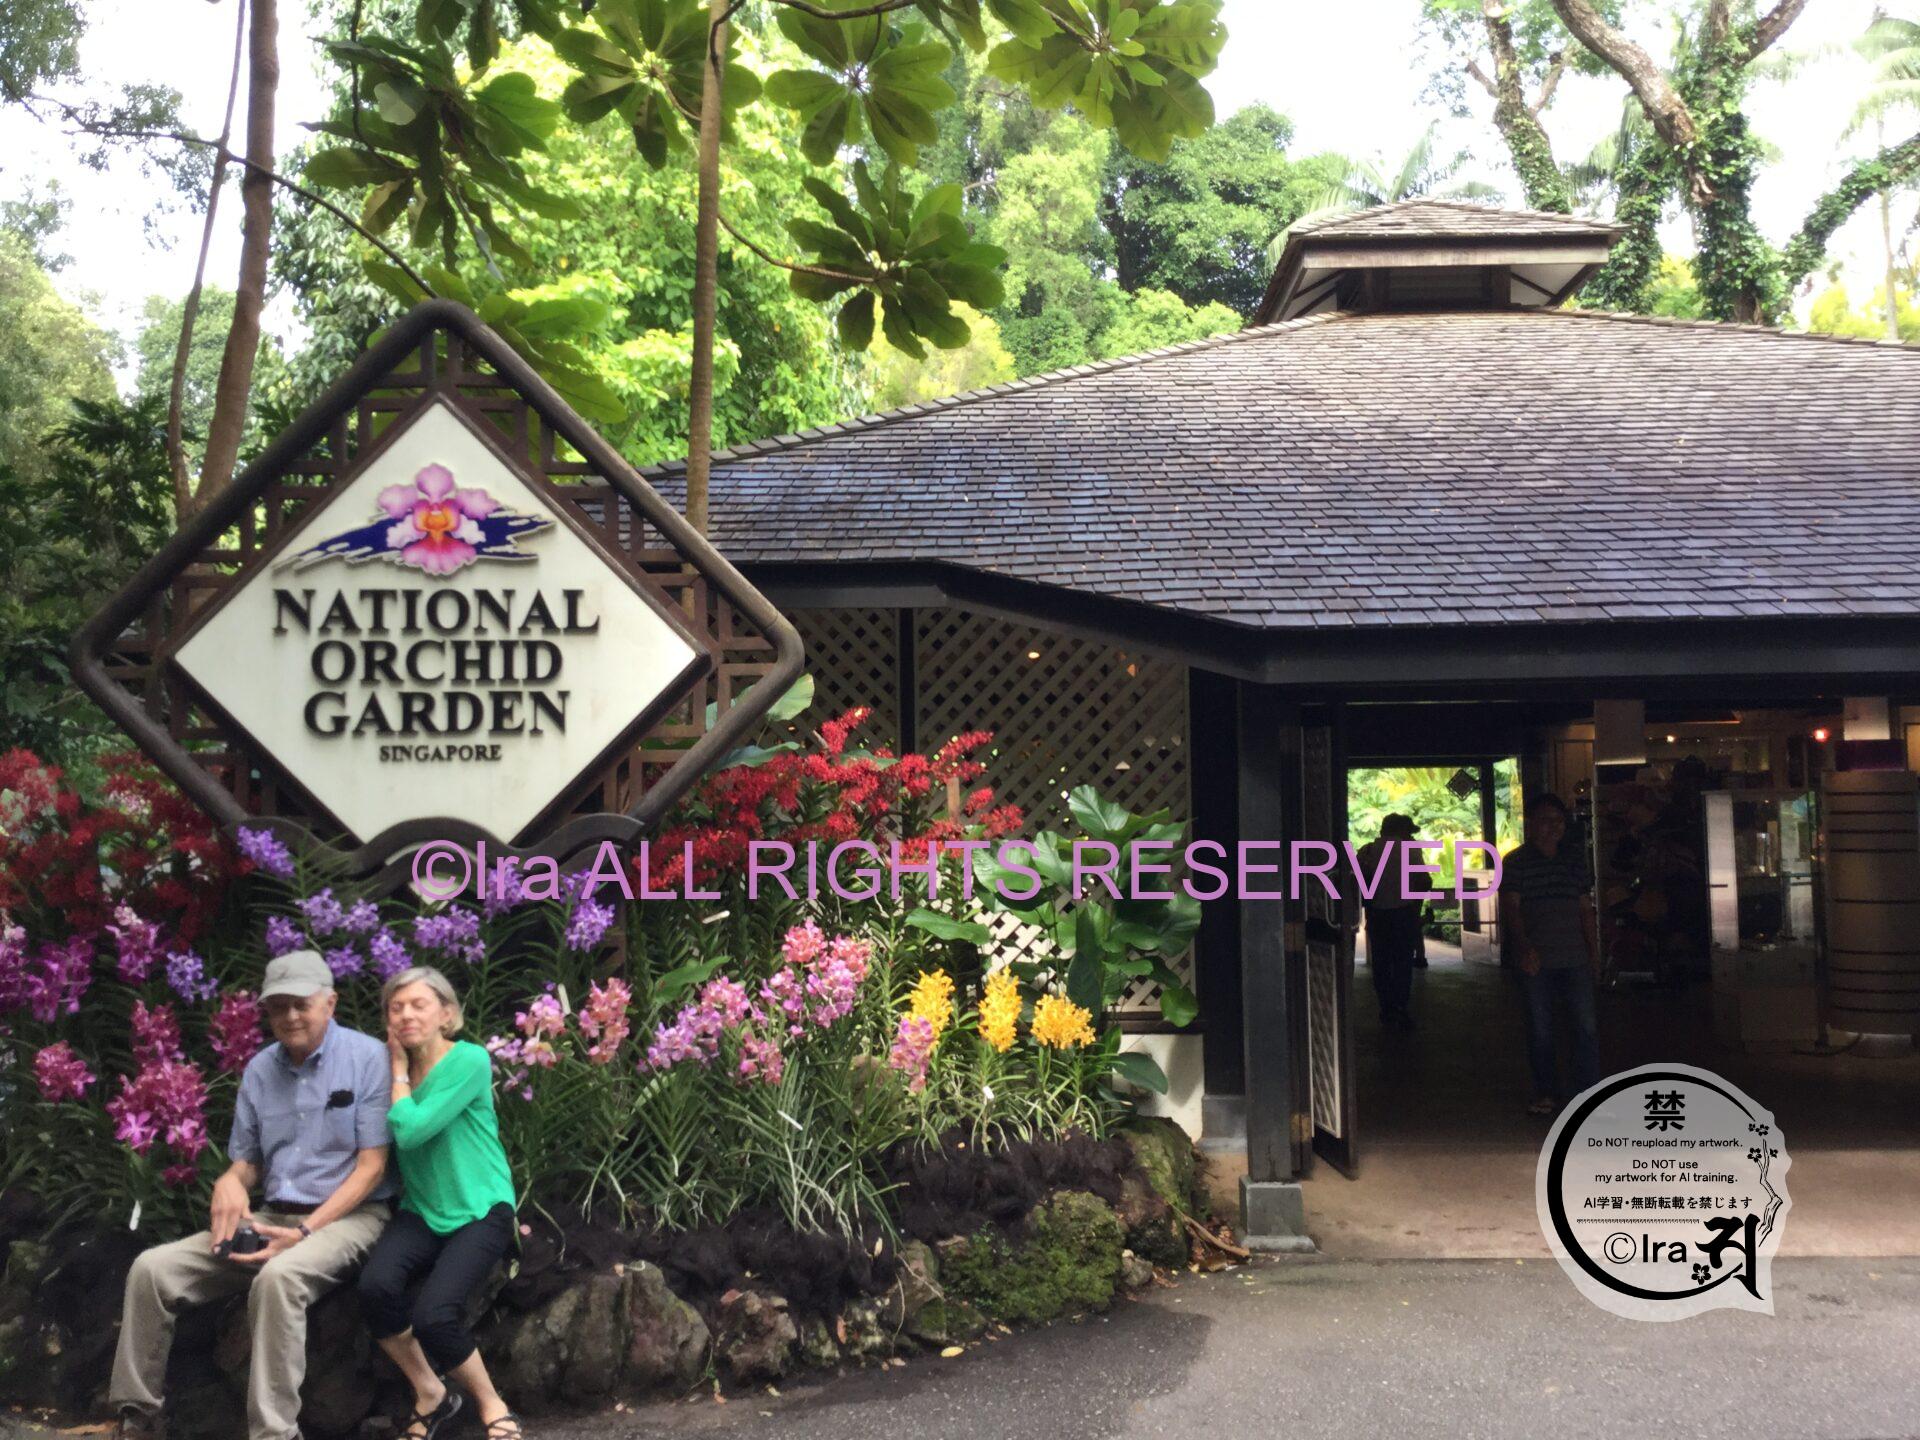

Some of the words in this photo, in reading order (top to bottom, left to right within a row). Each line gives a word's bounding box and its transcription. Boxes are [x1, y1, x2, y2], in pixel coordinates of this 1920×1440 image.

[273, 588, 600, 635] NATIONAL
[310, 639, 563, 686] ORCHID
[303, 690, 571, 738] GARDEN
[379, 744, 502, 763] SINGAPORE
